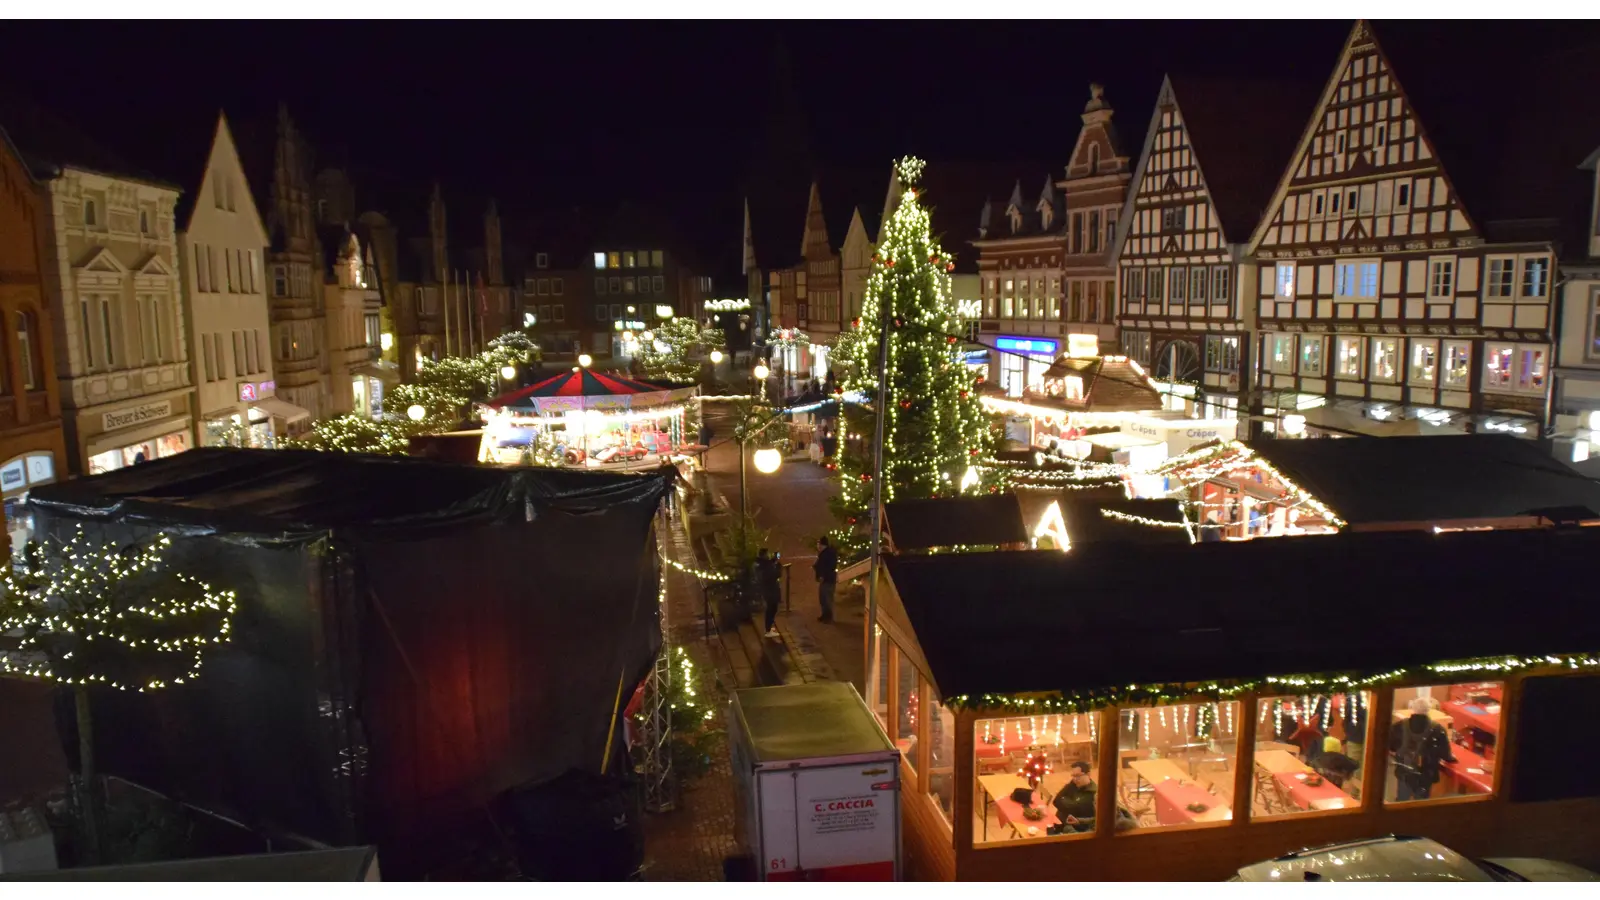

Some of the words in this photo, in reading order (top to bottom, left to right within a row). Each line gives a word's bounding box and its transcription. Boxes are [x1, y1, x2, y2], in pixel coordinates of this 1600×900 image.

[815, 803, 826, 812] C.
[828, 799, 875, 811] CACCIA
[771, 858, 787, 870] 61
